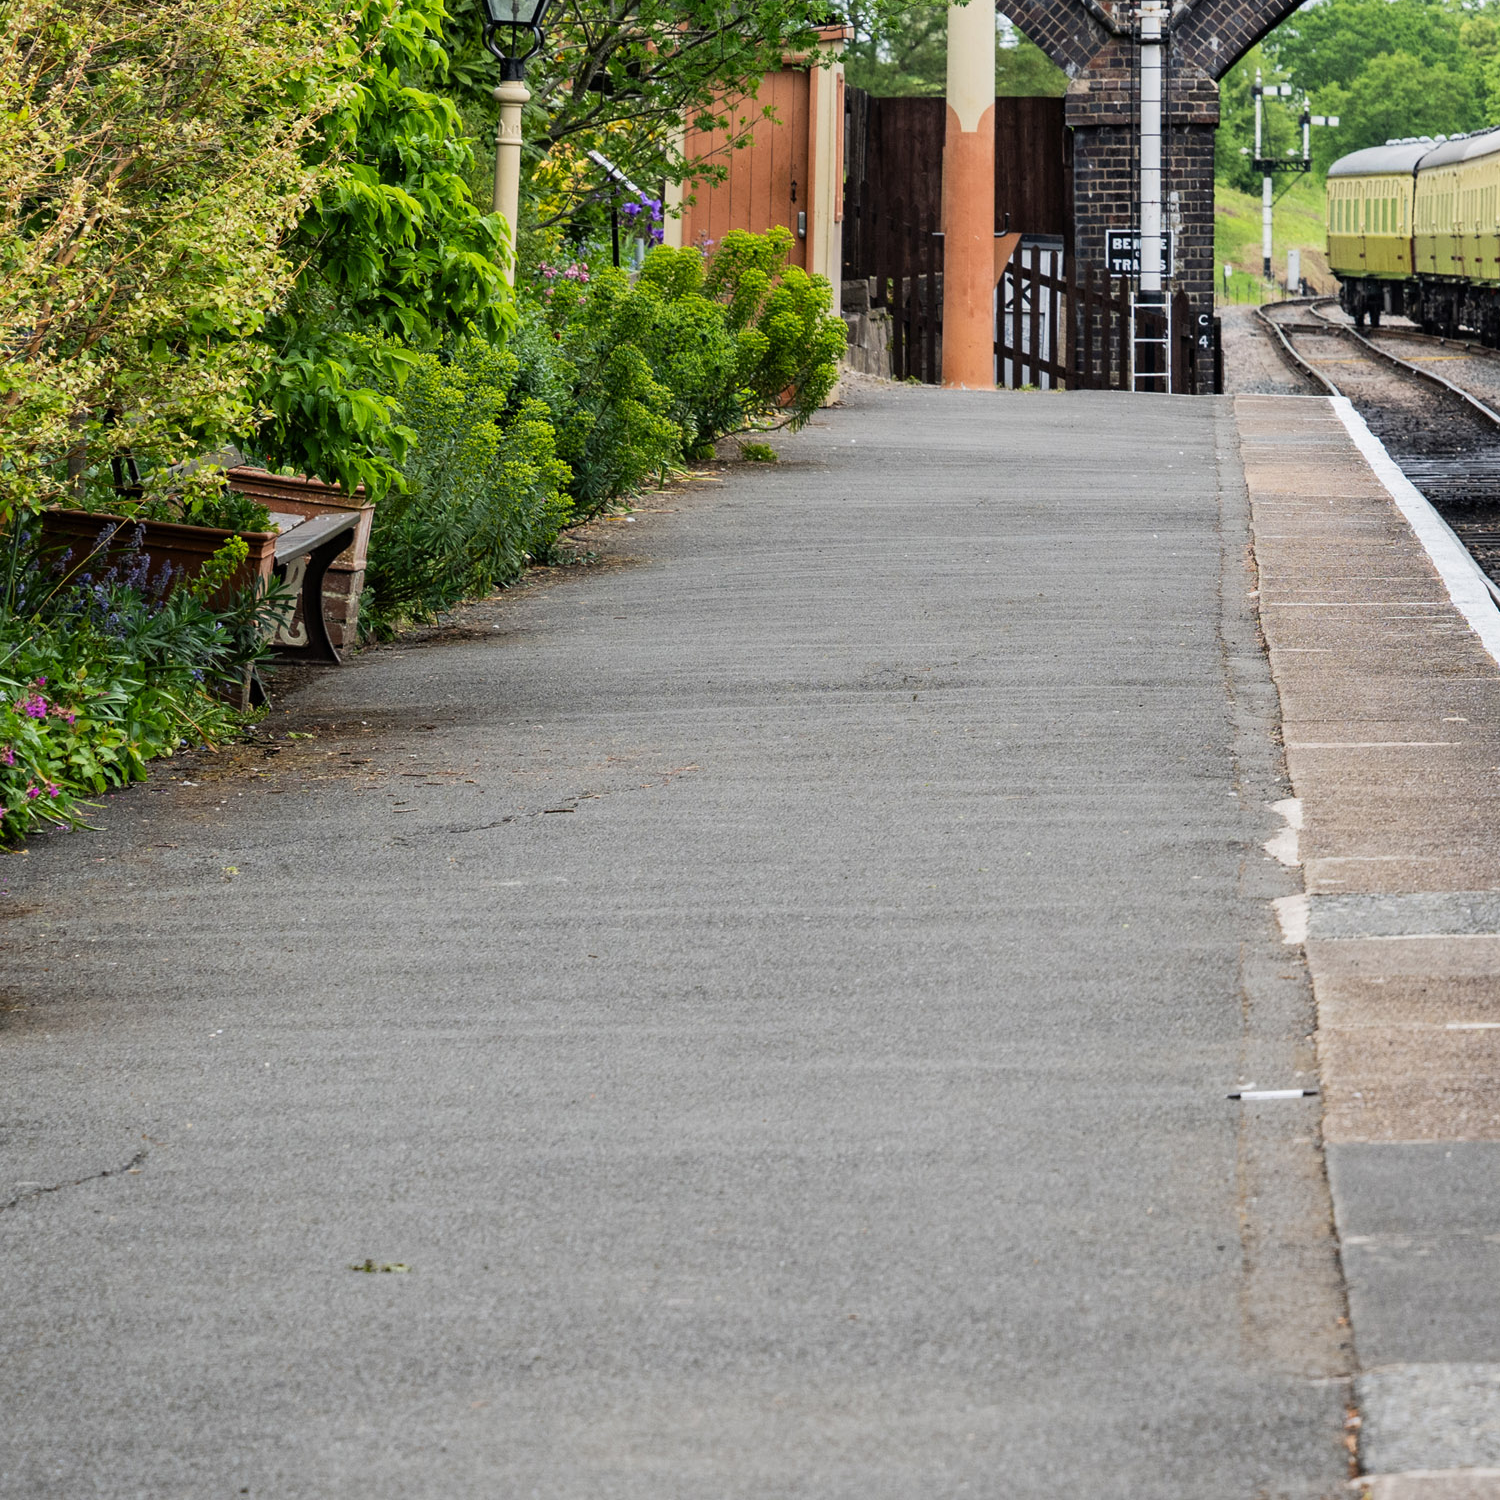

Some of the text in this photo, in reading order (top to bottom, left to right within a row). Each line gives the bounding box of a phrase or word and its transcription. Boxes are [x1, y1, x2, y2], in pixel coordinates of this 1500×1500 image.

[1112, 259, 1167, 271] TRAS
[1198, 314, 1209, 326] C
[1198, 335, 1209, 348] 4
